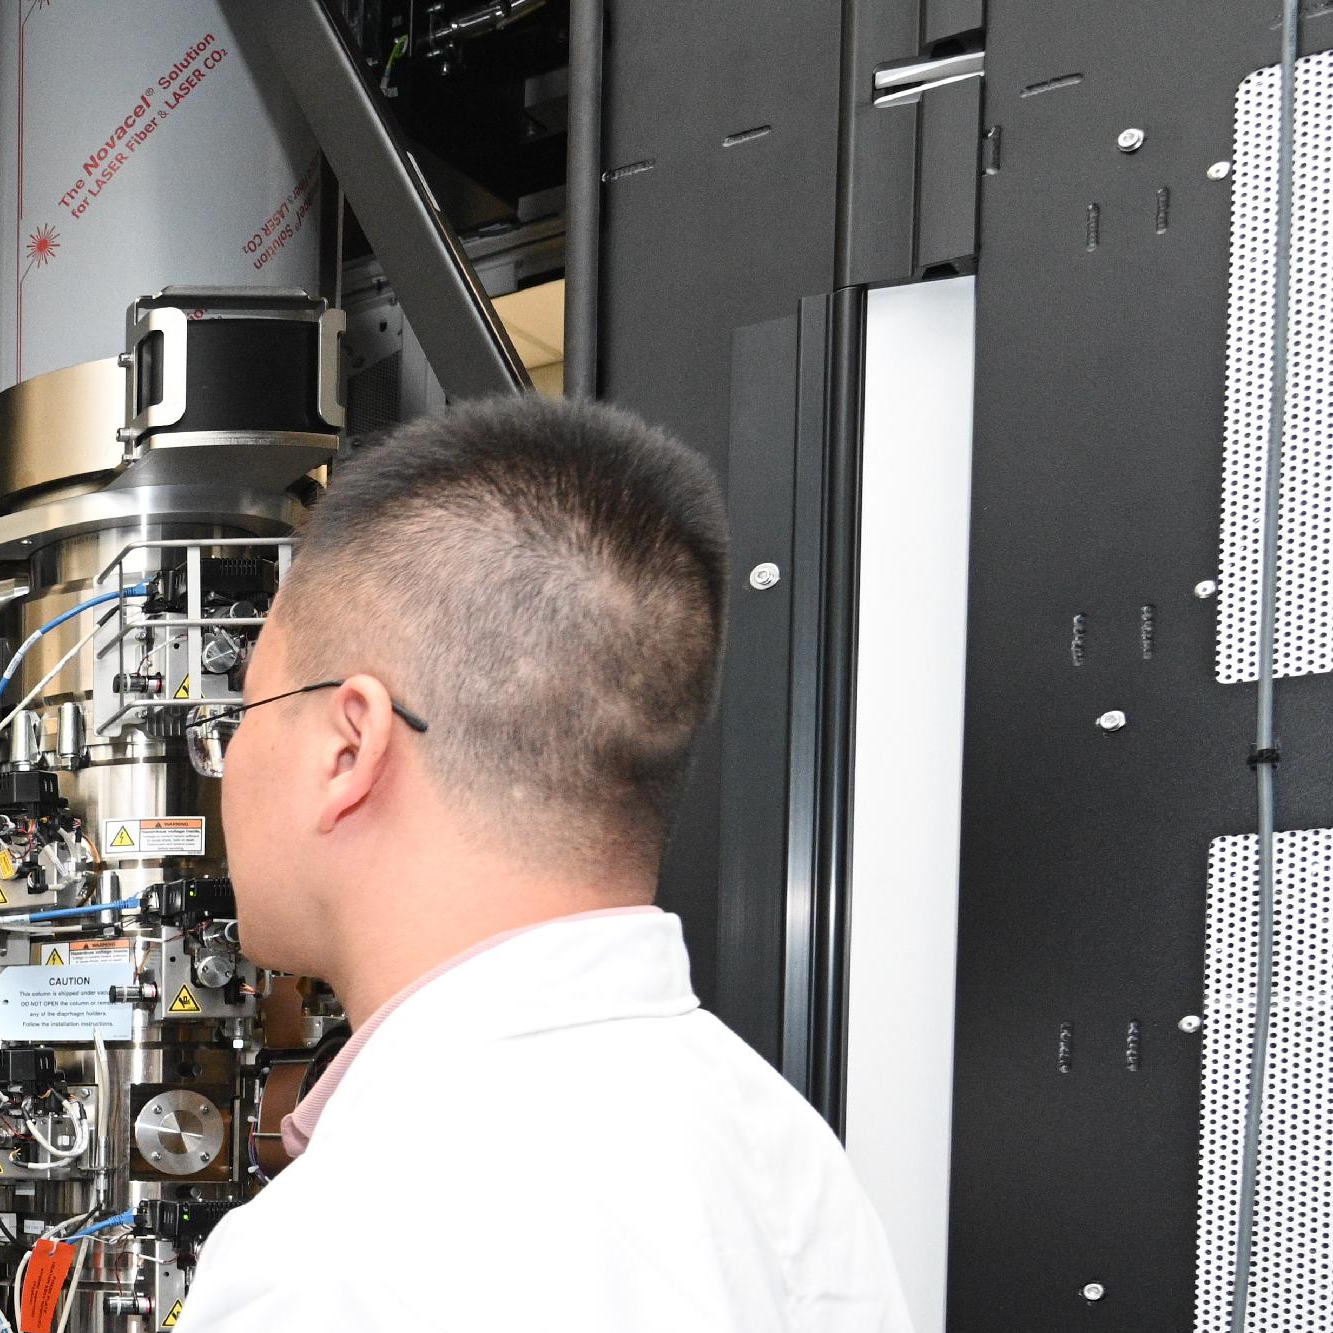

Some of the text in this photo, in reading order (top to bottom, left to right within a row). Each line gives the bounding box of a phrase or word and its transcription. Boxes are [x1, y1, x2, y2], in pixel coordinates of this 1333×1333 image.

[58, 179, 85, 208] The
[158, 33, 215, 90] Solution
[71, 196, 91, 219] for
[87, 152, 129, 197] LASER
[125, 117, 159, 153] Fiber
[157, 110, 169, 119] &
[164, 68, 206, 110] LASER
[48, 976, 90, 986] CAUTION
